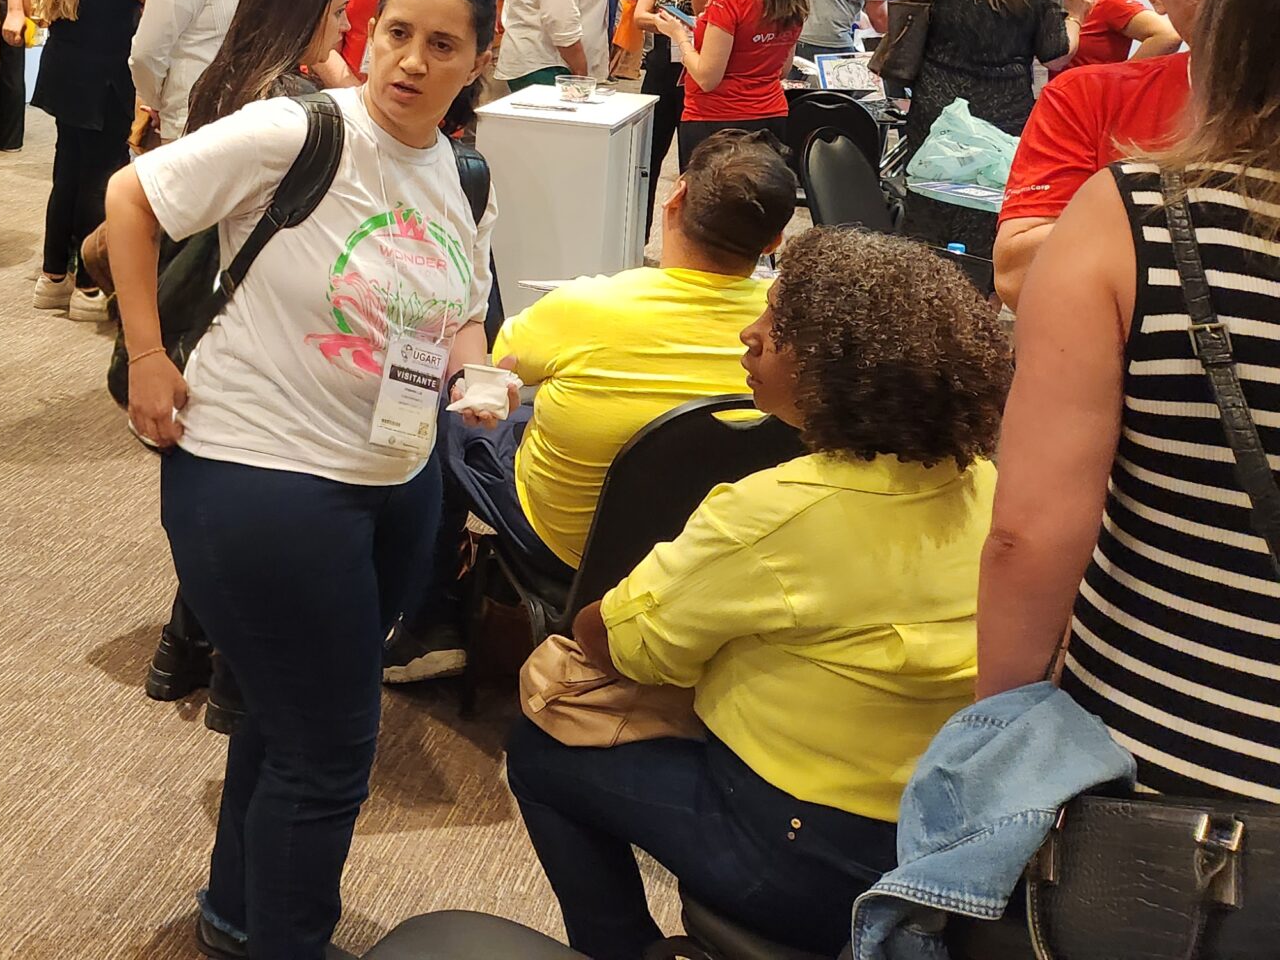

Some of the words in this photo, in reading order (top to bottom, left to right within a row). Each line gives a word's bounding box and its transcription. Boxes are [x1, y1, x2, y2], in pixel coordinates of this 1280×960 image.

[379, 244, 447, 271] WONDER
[413, 350, 442, 367] UGART
[396, 370, 438, 388] VISITANTE
